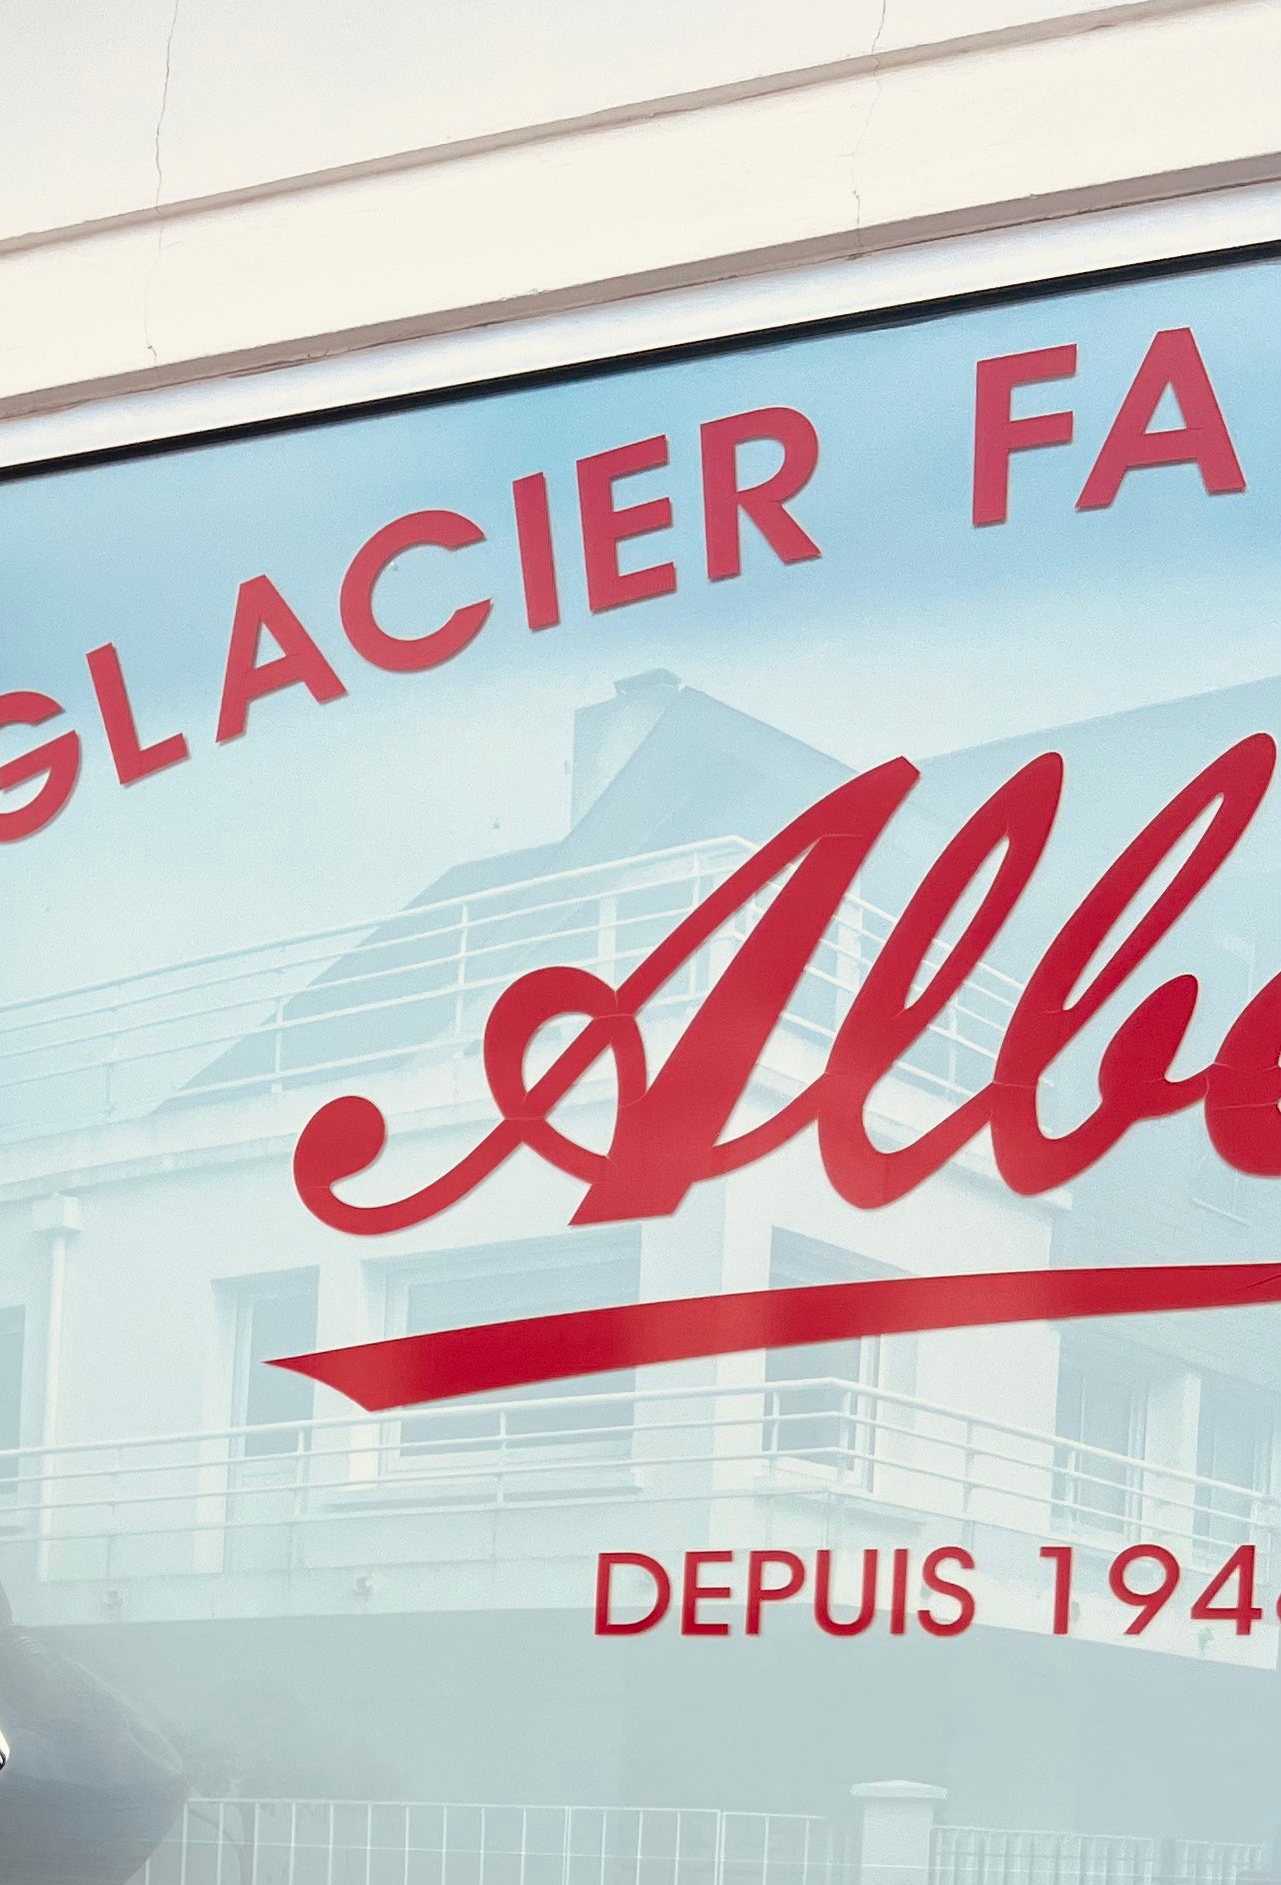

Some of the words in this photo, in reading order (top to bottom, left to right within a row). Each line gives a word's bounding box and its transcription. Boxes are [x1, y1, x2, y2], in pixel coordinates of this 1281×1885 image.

[972, 327, 1247, 528] FA
[594, 1545, 977, 1638] DEPUIS
[1039, 1543, 1281, 1638] 194
